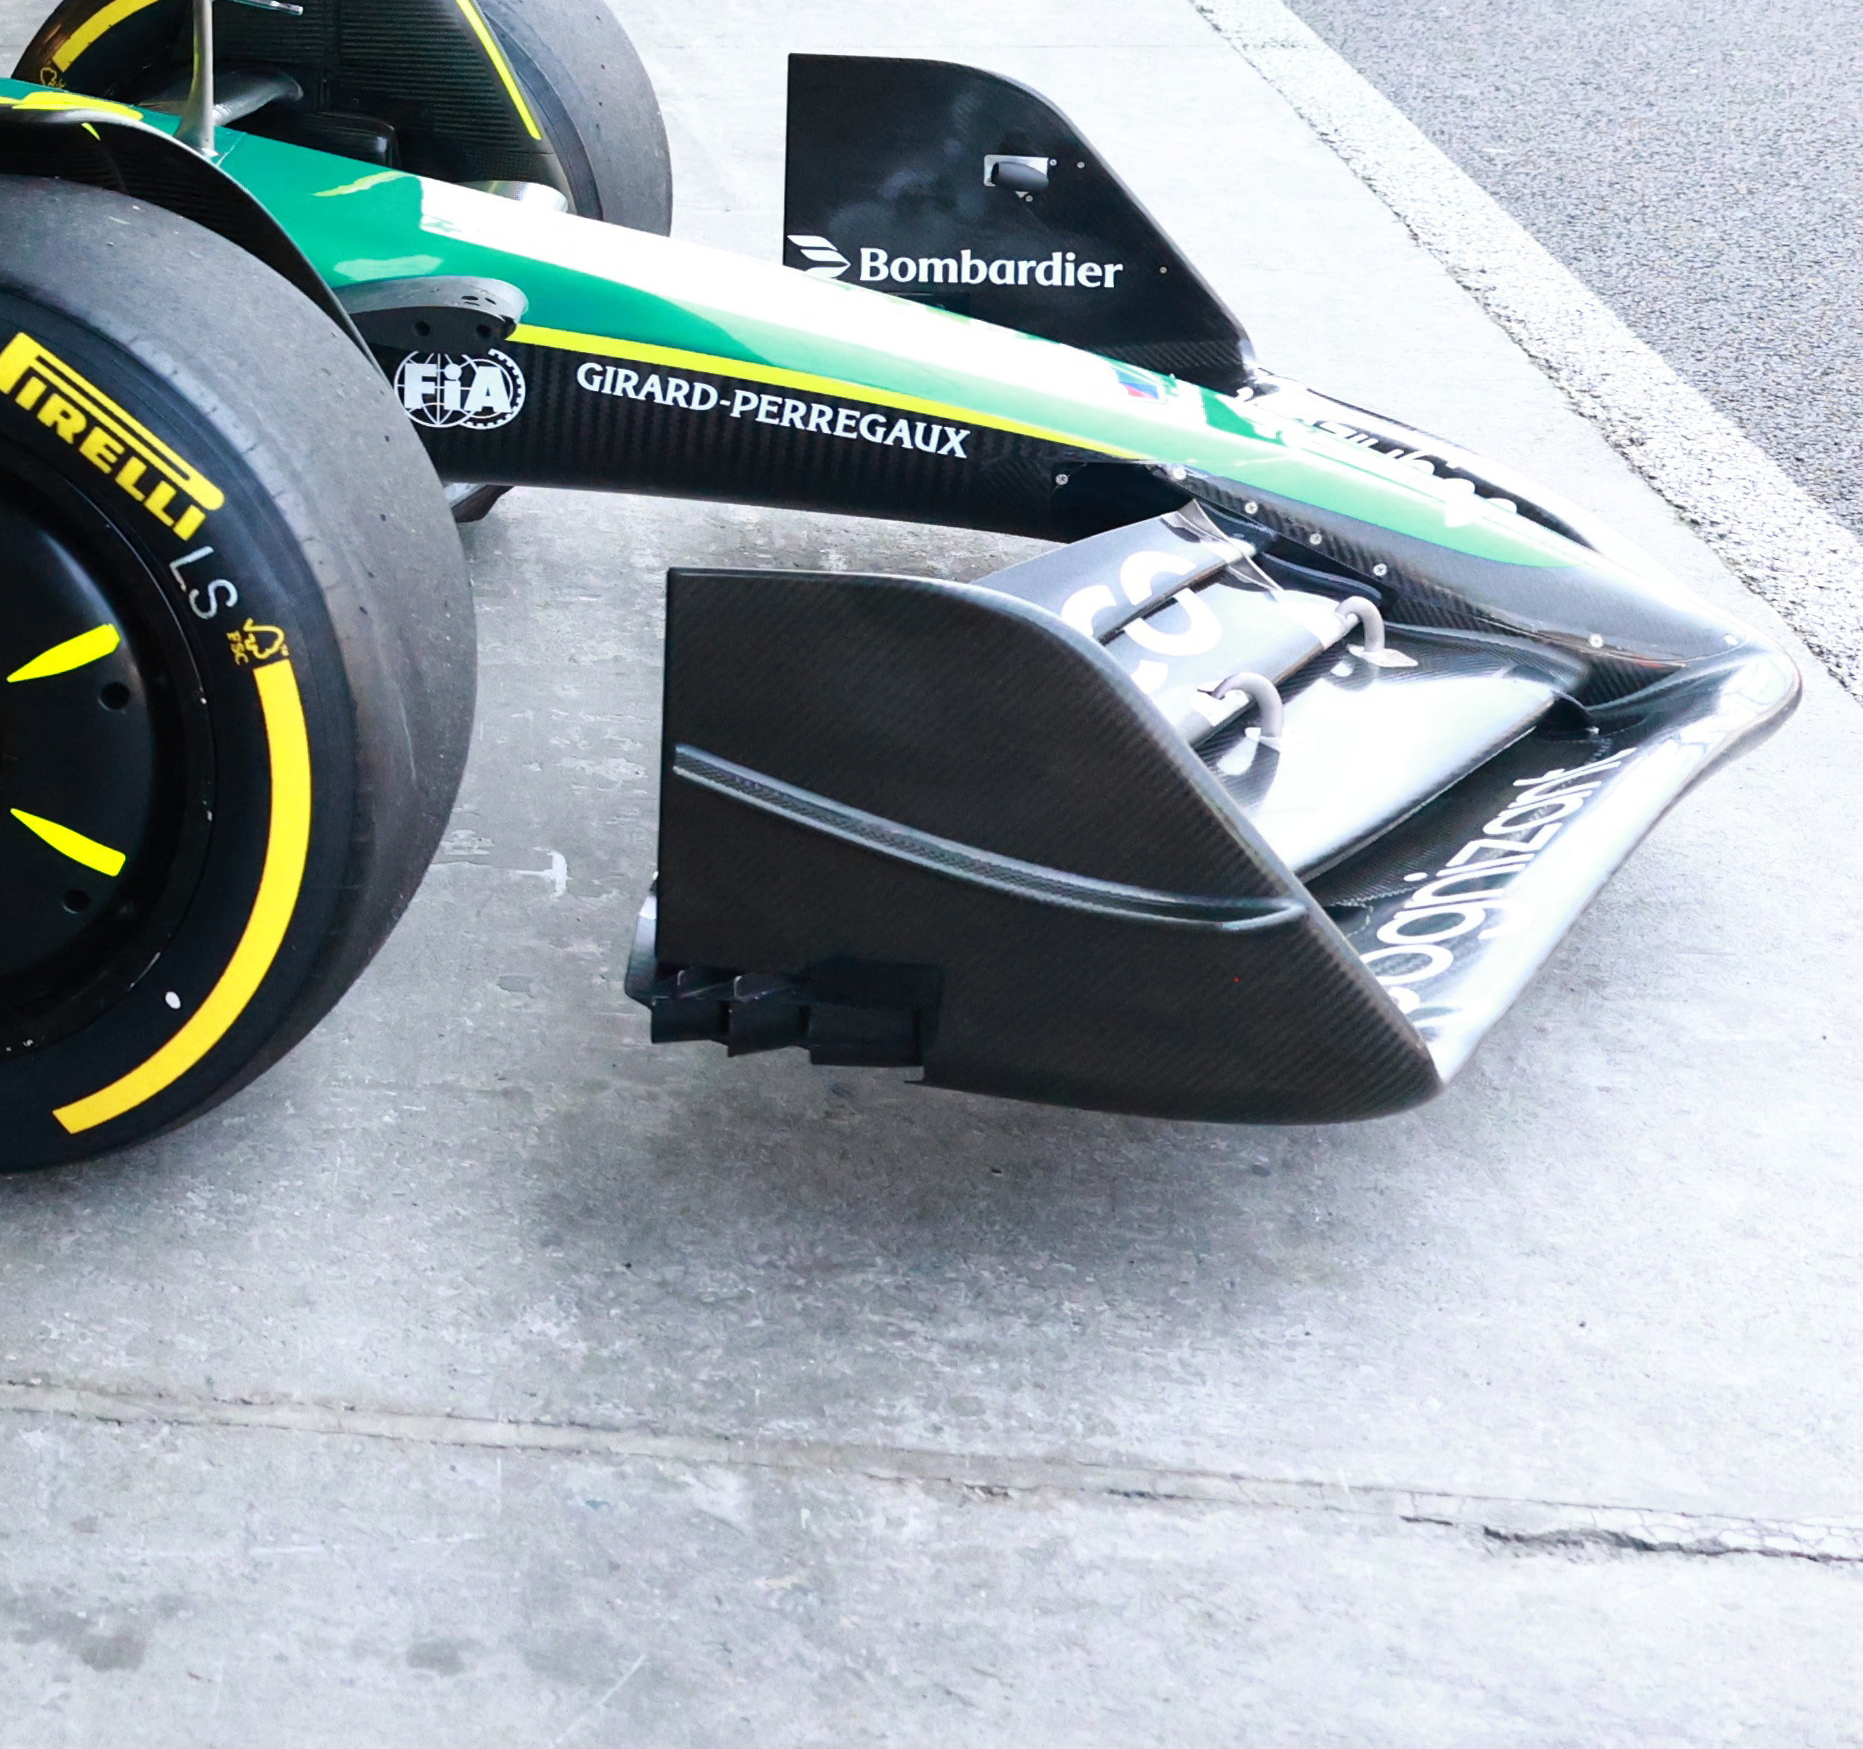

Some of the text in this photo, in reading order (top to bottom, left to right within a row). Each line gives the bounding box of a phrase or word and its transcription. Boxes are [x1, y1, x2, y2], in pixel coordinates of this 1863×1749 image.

[858, 246, 1125, 291] Bombardier
[576, 362, 971, 460] GIRARD-PERREGAUX
[169, 545, 239, 620] LS
